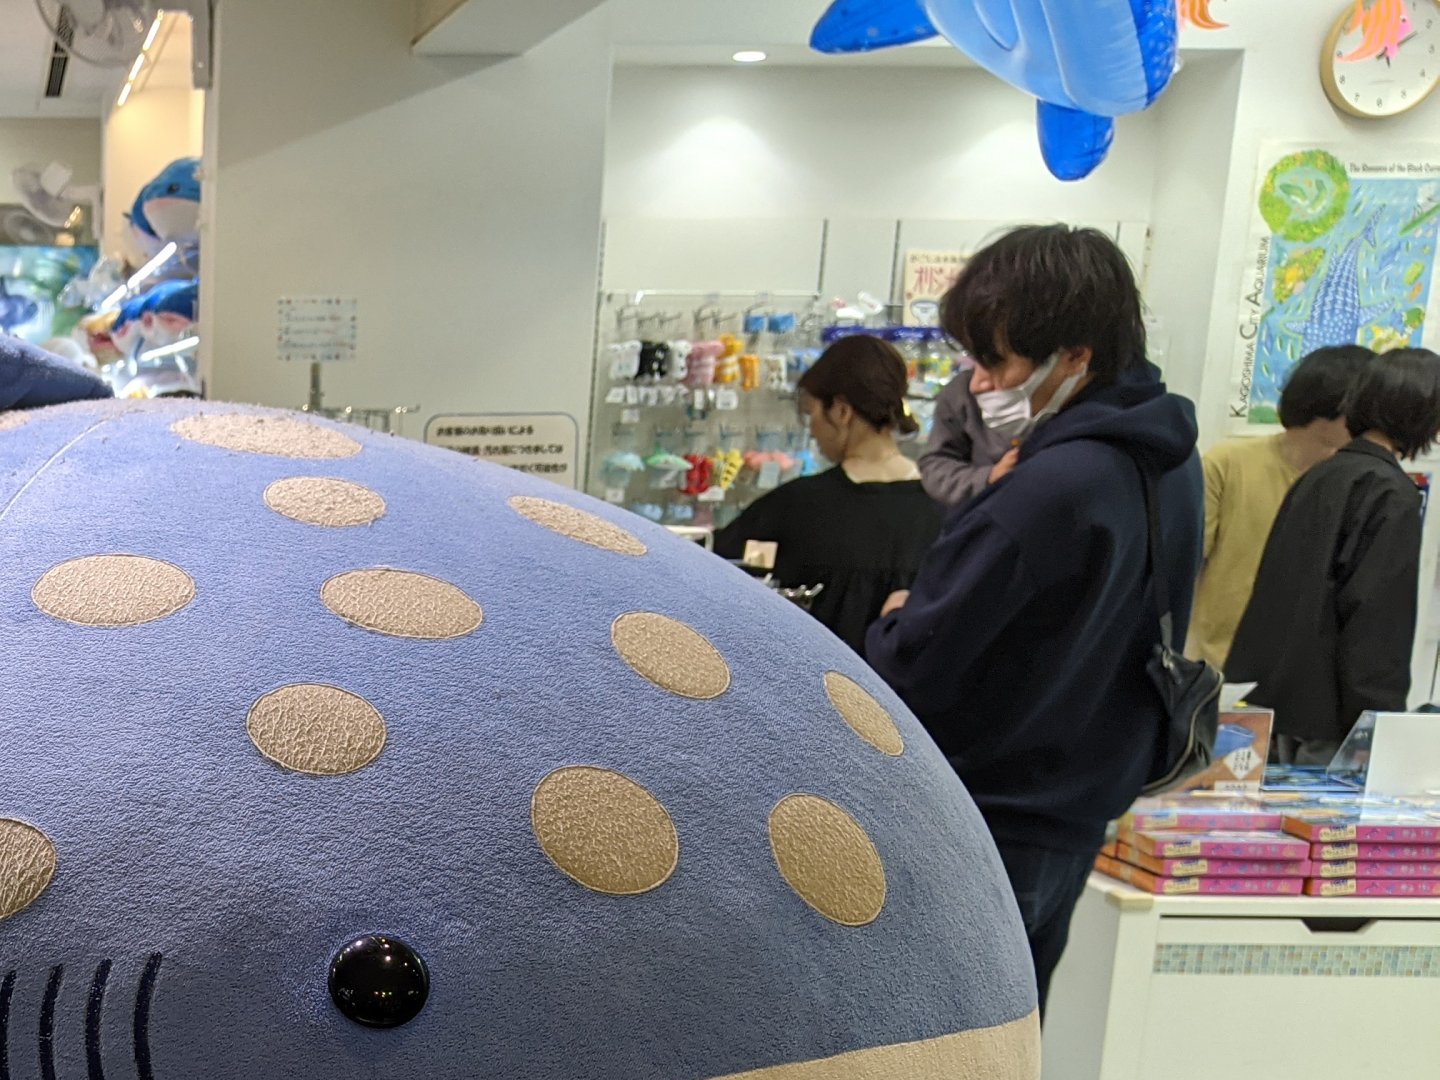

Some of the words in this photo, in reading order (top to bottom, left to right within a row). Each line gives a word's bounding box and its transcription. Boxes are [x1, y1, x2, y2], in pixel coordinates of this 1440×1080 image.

[1245, 236, 1269, 307] AQUARIUM
[1239, 309, 1259, 340] CITY
[1229, 341, 1255, 419] KAGOSHIMA
